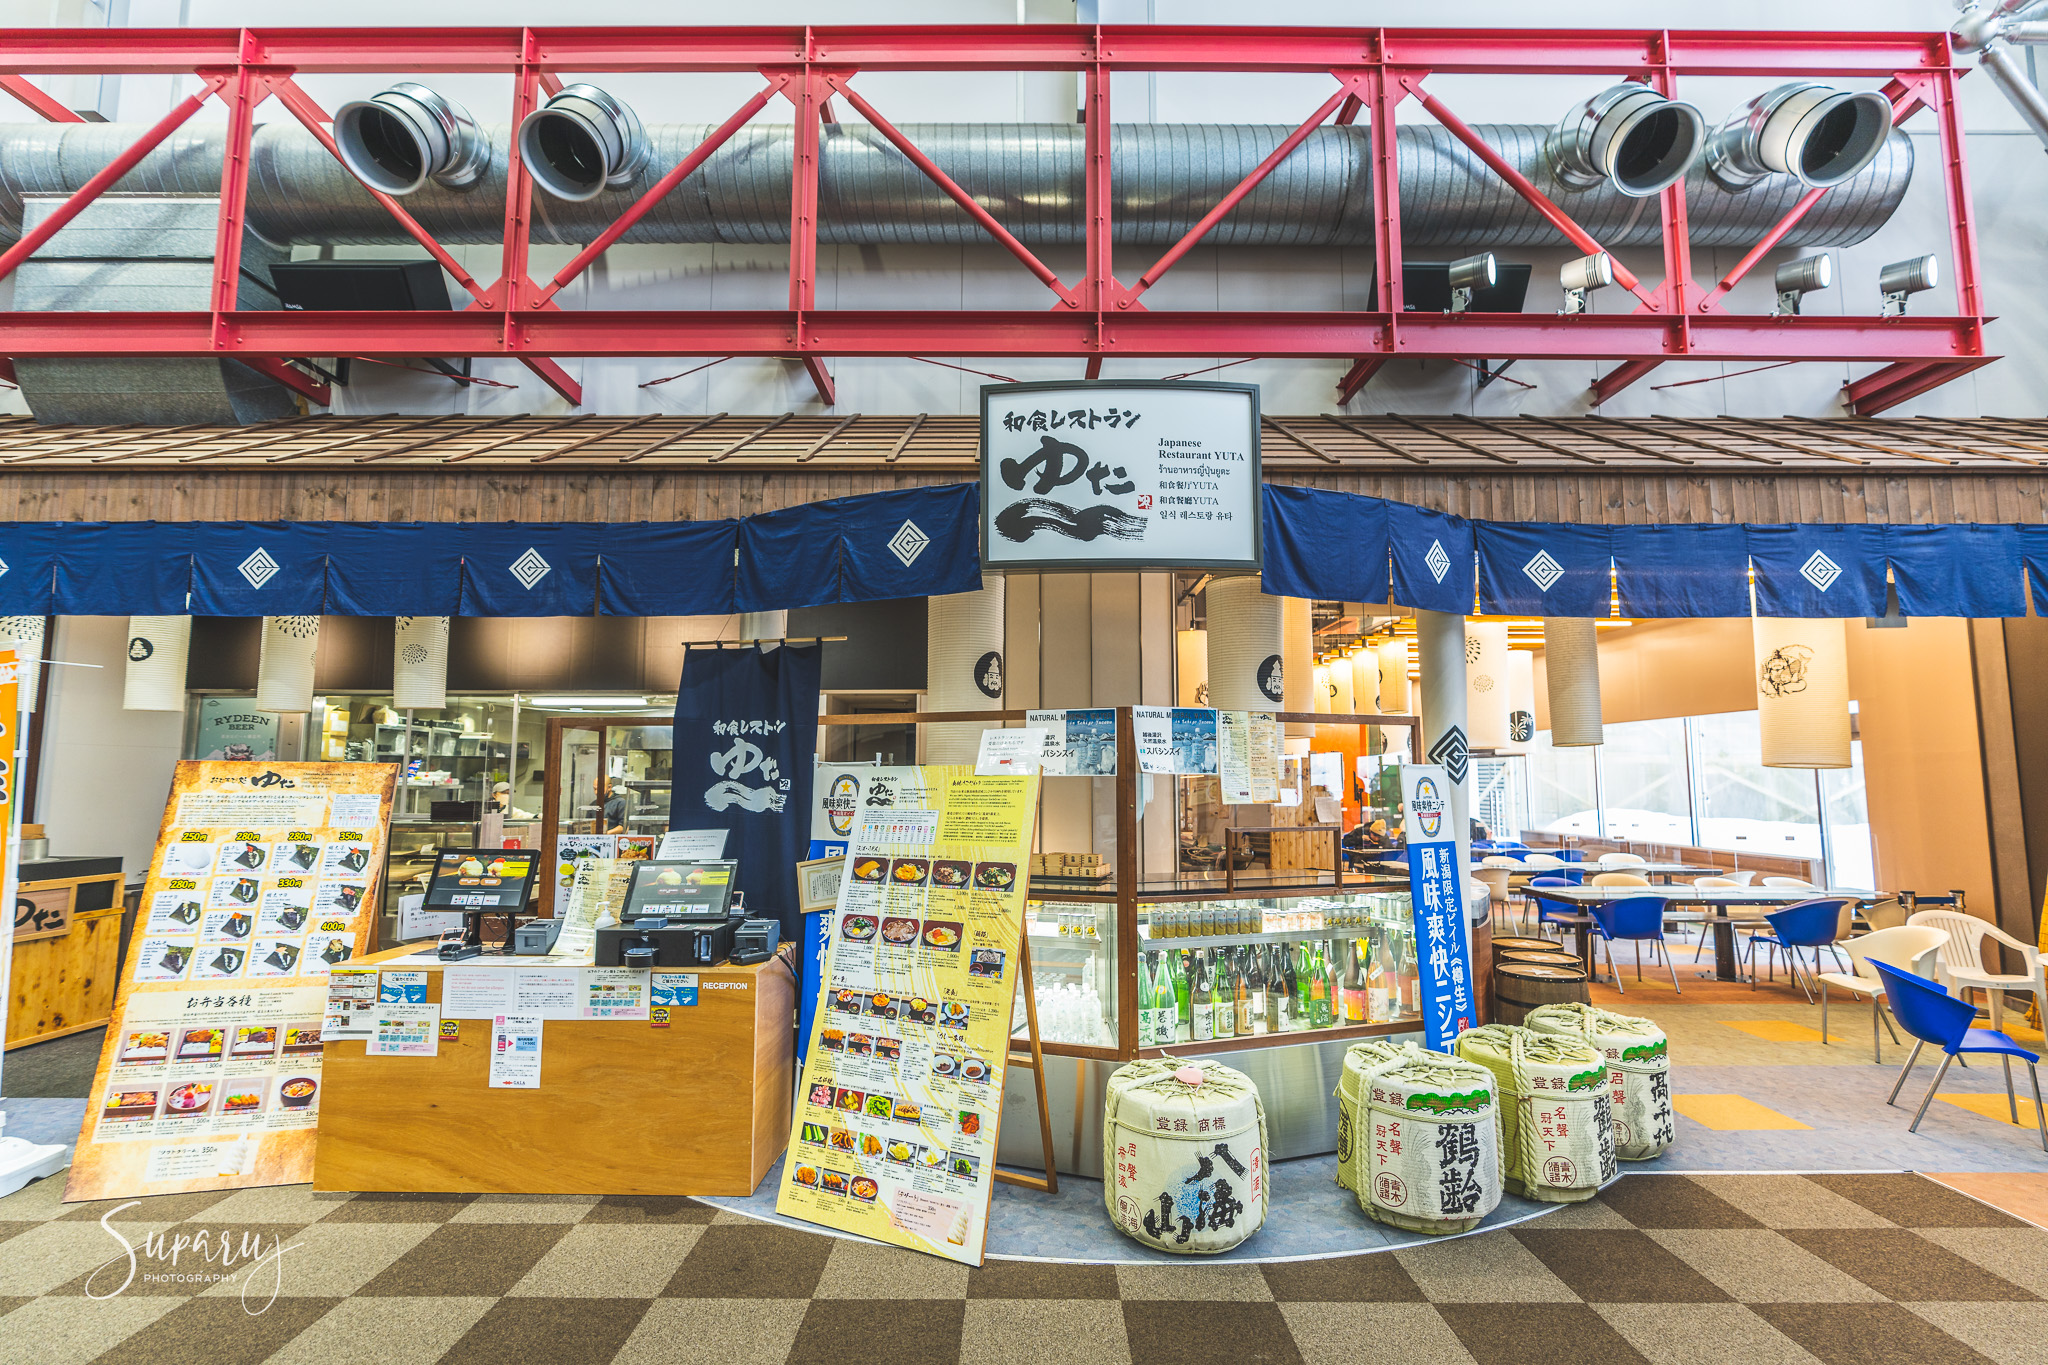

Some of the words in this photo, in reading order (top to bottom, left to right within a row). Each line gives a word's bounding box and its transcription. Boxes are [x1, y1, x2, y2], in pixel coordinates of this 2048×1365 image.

[1003, 408, 1141, 432] 和食レストラン
[1158, 437, 1202, 449] Japanese
[1158, 449, 1212, 460] Restaurant
[1214, 451, 1245, 461] YUTA
[1000, 435, 1135, 495] ゆた
[1159, 510, 1176, 520] 일식
[1179, 510, 1214, 521] 레스토랑
[1215, 511, 1233, 521] 유타
[214, 714, 270, 726] RYDEEN
[1029, 714, 1059, 722] NATURAL
[1090, 712, 1113, 720] WATER
[228, 723, 255, 731] BEER
[712, 719, 787, 736] 和食レストン
[1411, 800, 1445, 812] 風味爽快ニシテ
[181, 832, 208, 842] 250円
[235, 831, 261, 842] 280円
[287, 831, 312, 841] 280円
[339, 831, 363, 841] 350円
[169, 878, 196, 889] 280円
[278, 878, 302, 888] 330円
[321, 921, 346, 931] 400円
[702, 982, 748, 990] RECEPTION
[186, 994, 252, 1009] お弁当各種
